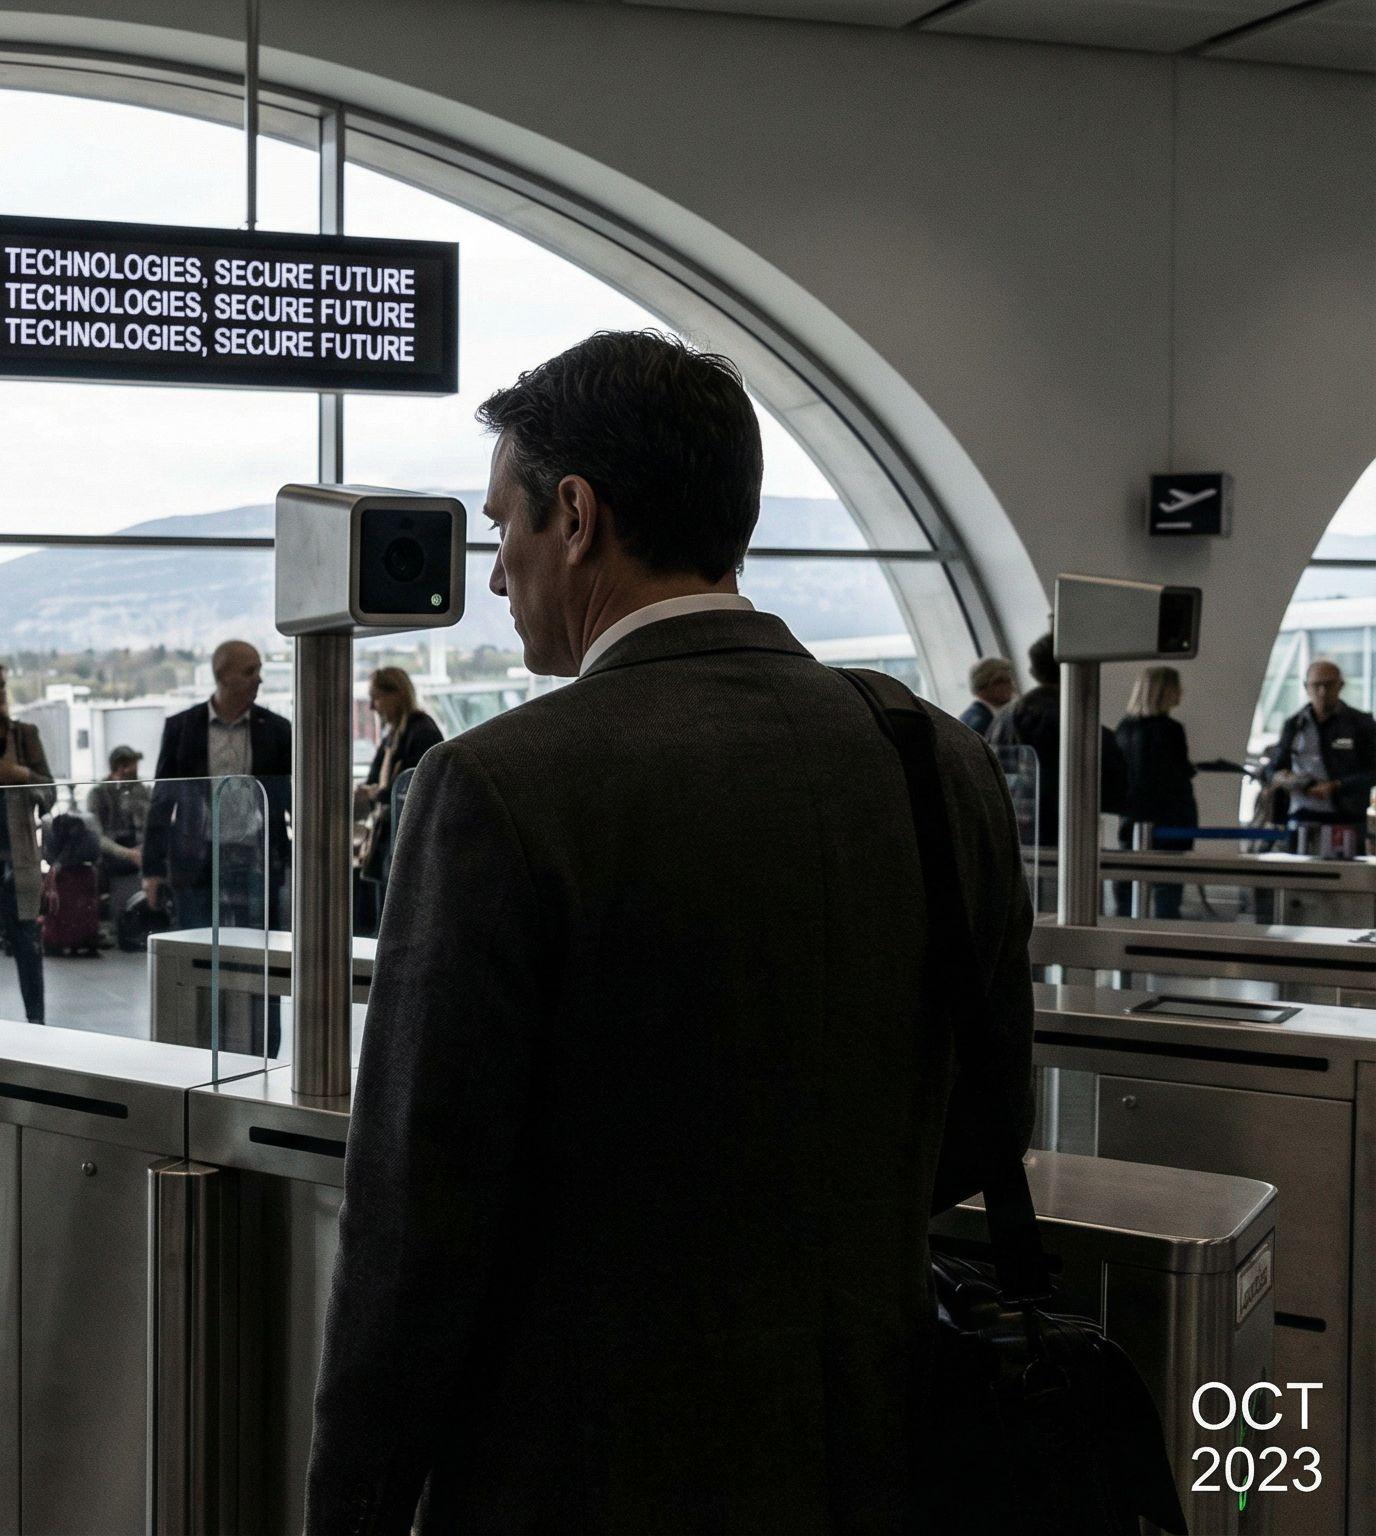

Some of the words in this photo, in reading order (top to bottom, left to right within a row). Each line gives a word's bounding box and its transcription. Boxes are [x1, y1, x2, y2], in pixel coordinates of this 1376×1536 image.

[5, 247, 207, 288] TECHNOLOGIES,
[215, 259, 313, 289] SECURE
[321, 265, 415, 294] FUTURE
[5, 283, 207, 323] TECHNOLOGIES,
[215, 294, 313, 323] SECURE
[321, 299, 415, 328] FUTURE
[5, 318, 207, 357] TECHNOLOGIES,
[215, 328, 313, 357] SECURE
[321, 333, 414, 361] FUTURE
